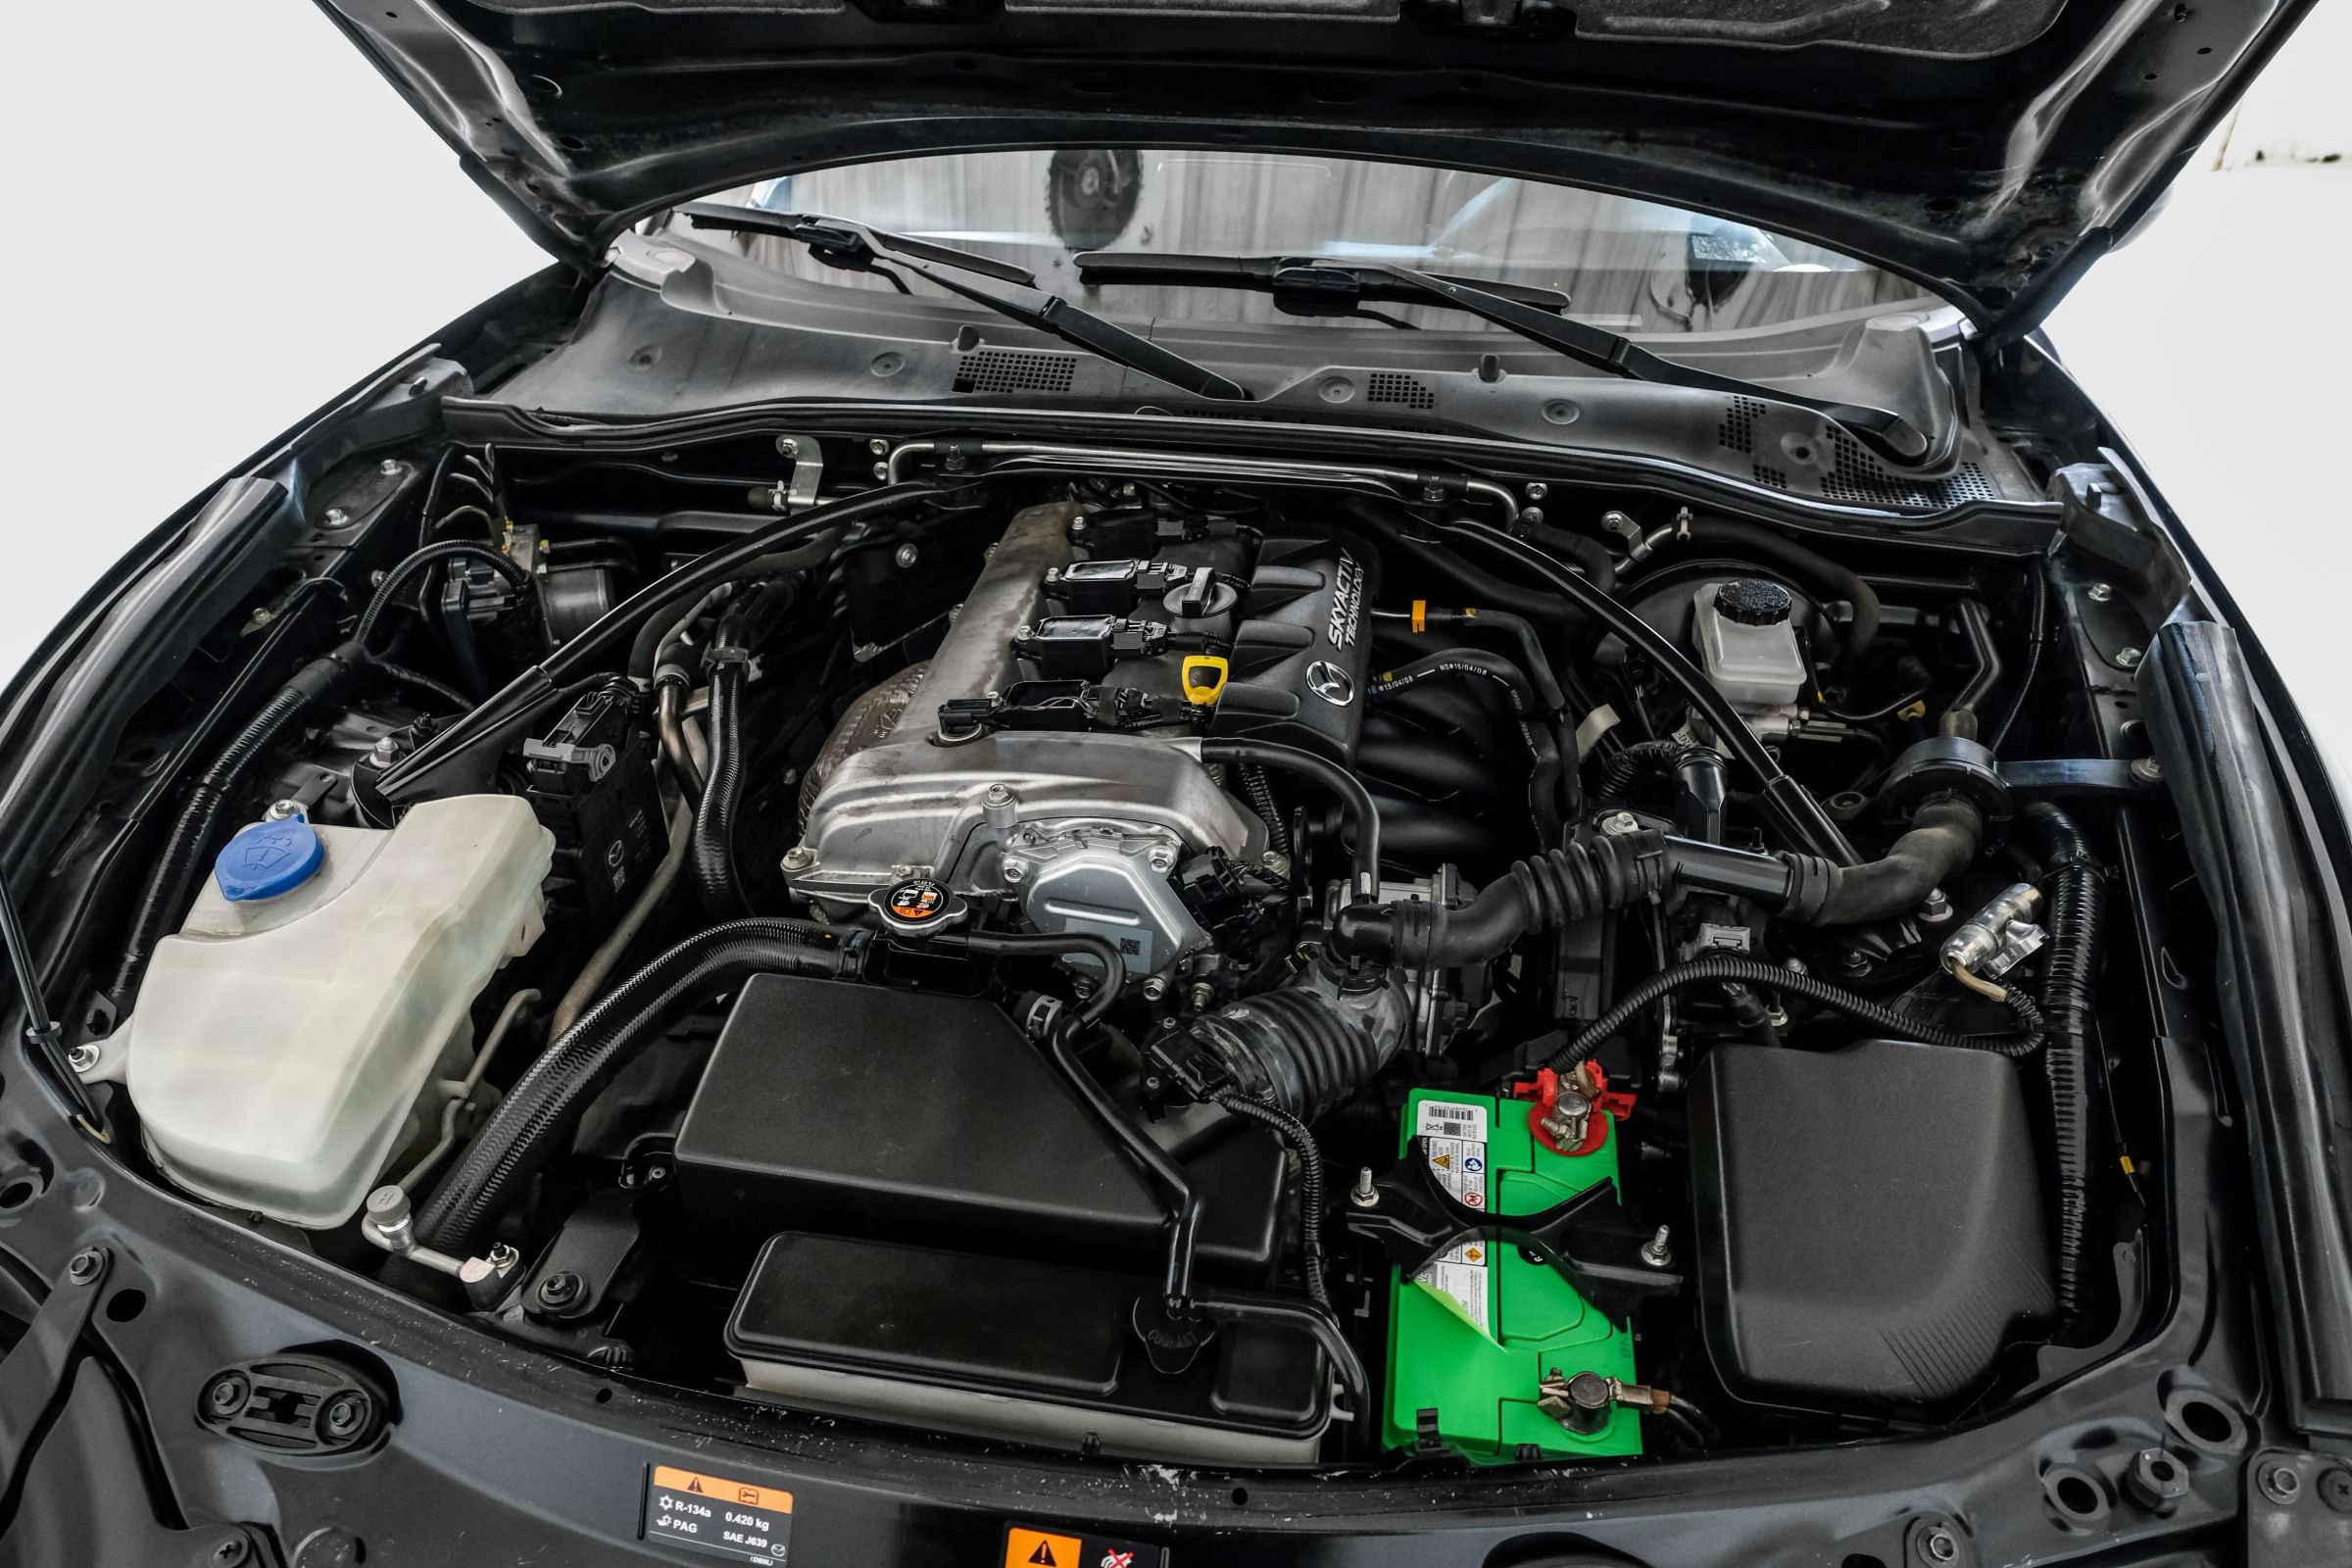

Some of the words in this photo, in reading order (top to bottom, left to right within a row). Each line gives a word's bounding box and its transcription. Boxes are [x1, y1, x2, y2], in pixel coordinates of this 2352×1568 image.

[1328, 546, 1354, 652] SKYACTIV
[1346, 561, 1364, 647] TECHNOLOGY
[675, 1500, 711, 1518] R-134a
[673, 1519, 698, 1534] PAG
[725, 1511, 754, 1527] 0.420
[756, 1518, 770, 1532] kg
[723, 1531, 744, 1544] SAE
[745, 1534, 768, 1548] J639
